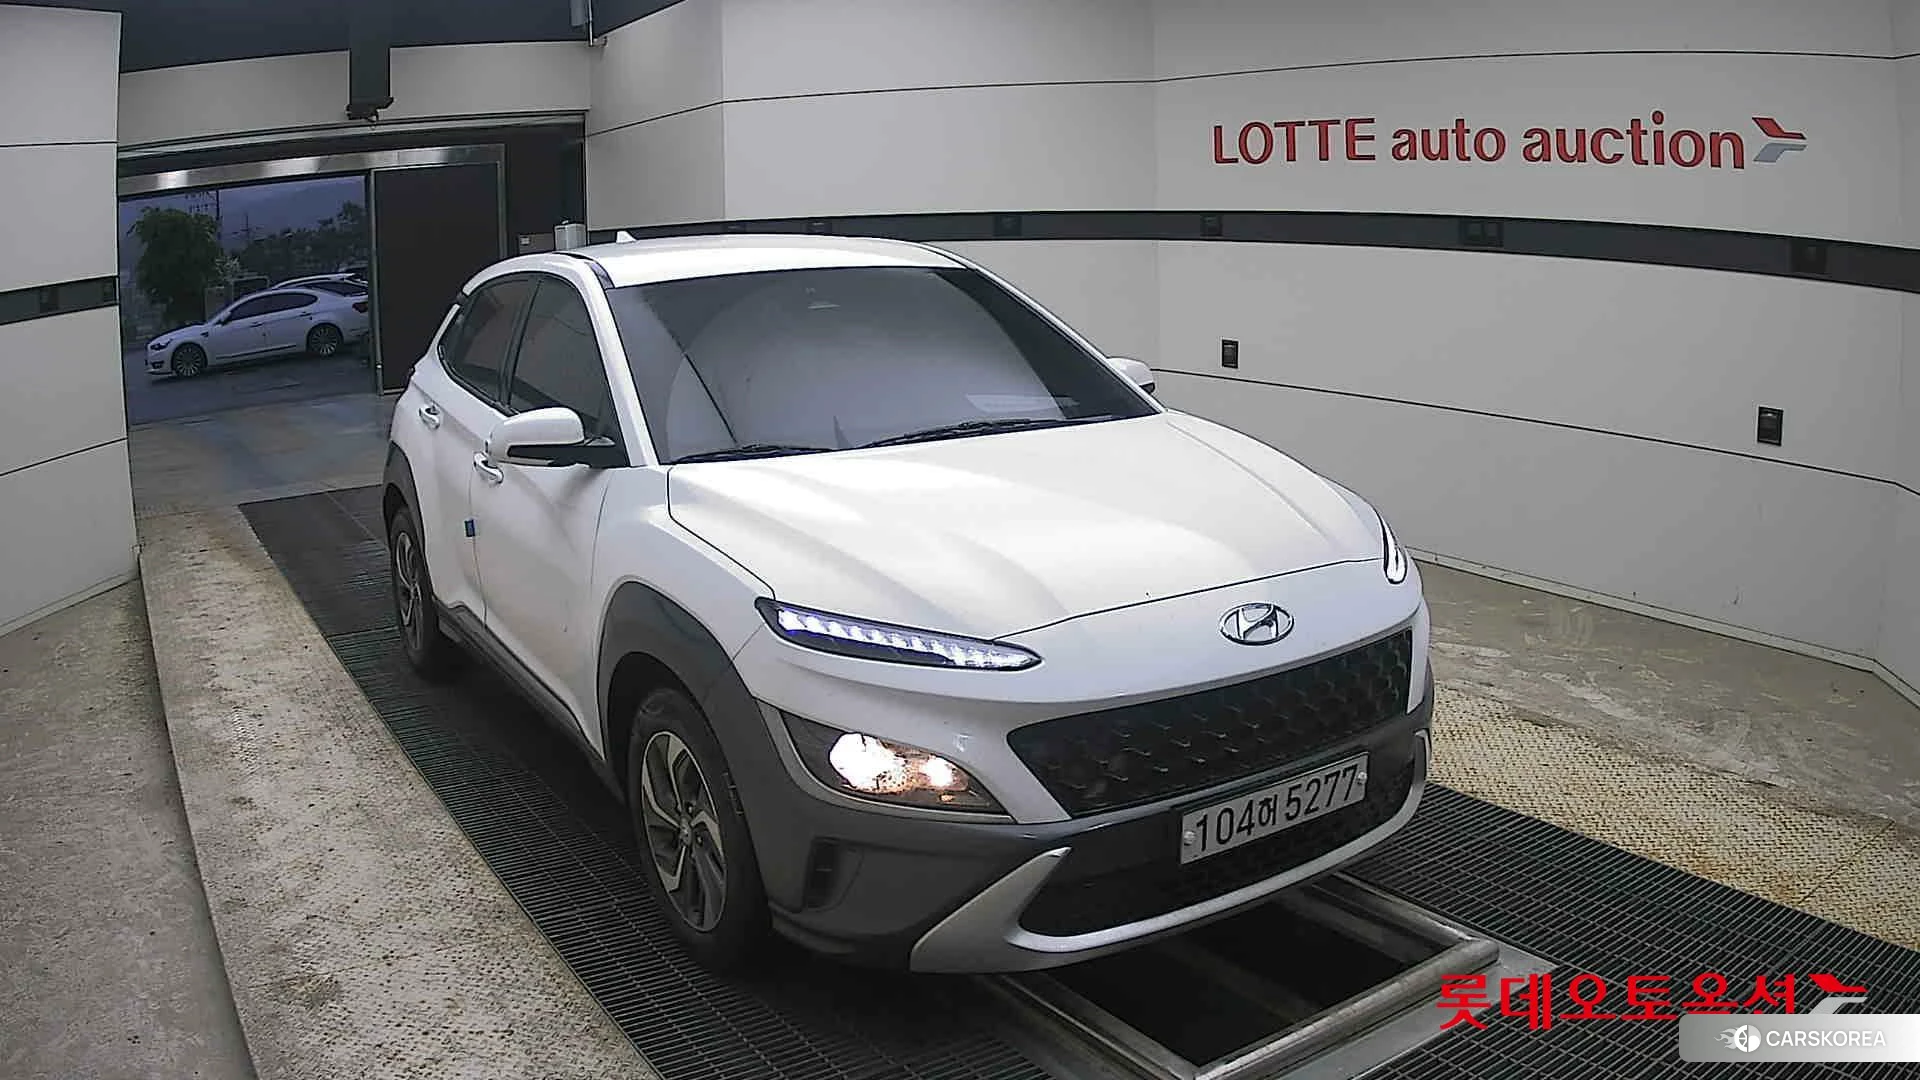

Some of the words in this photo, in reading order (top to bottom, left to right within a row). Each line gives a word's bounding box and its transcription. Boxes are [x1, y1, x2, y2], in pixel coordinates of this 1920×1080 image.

[1213, 117, 1377, 165] LOTTE
[1391, 118, 1507, 162] auto
[1521, 111, 1746, 170] auction
